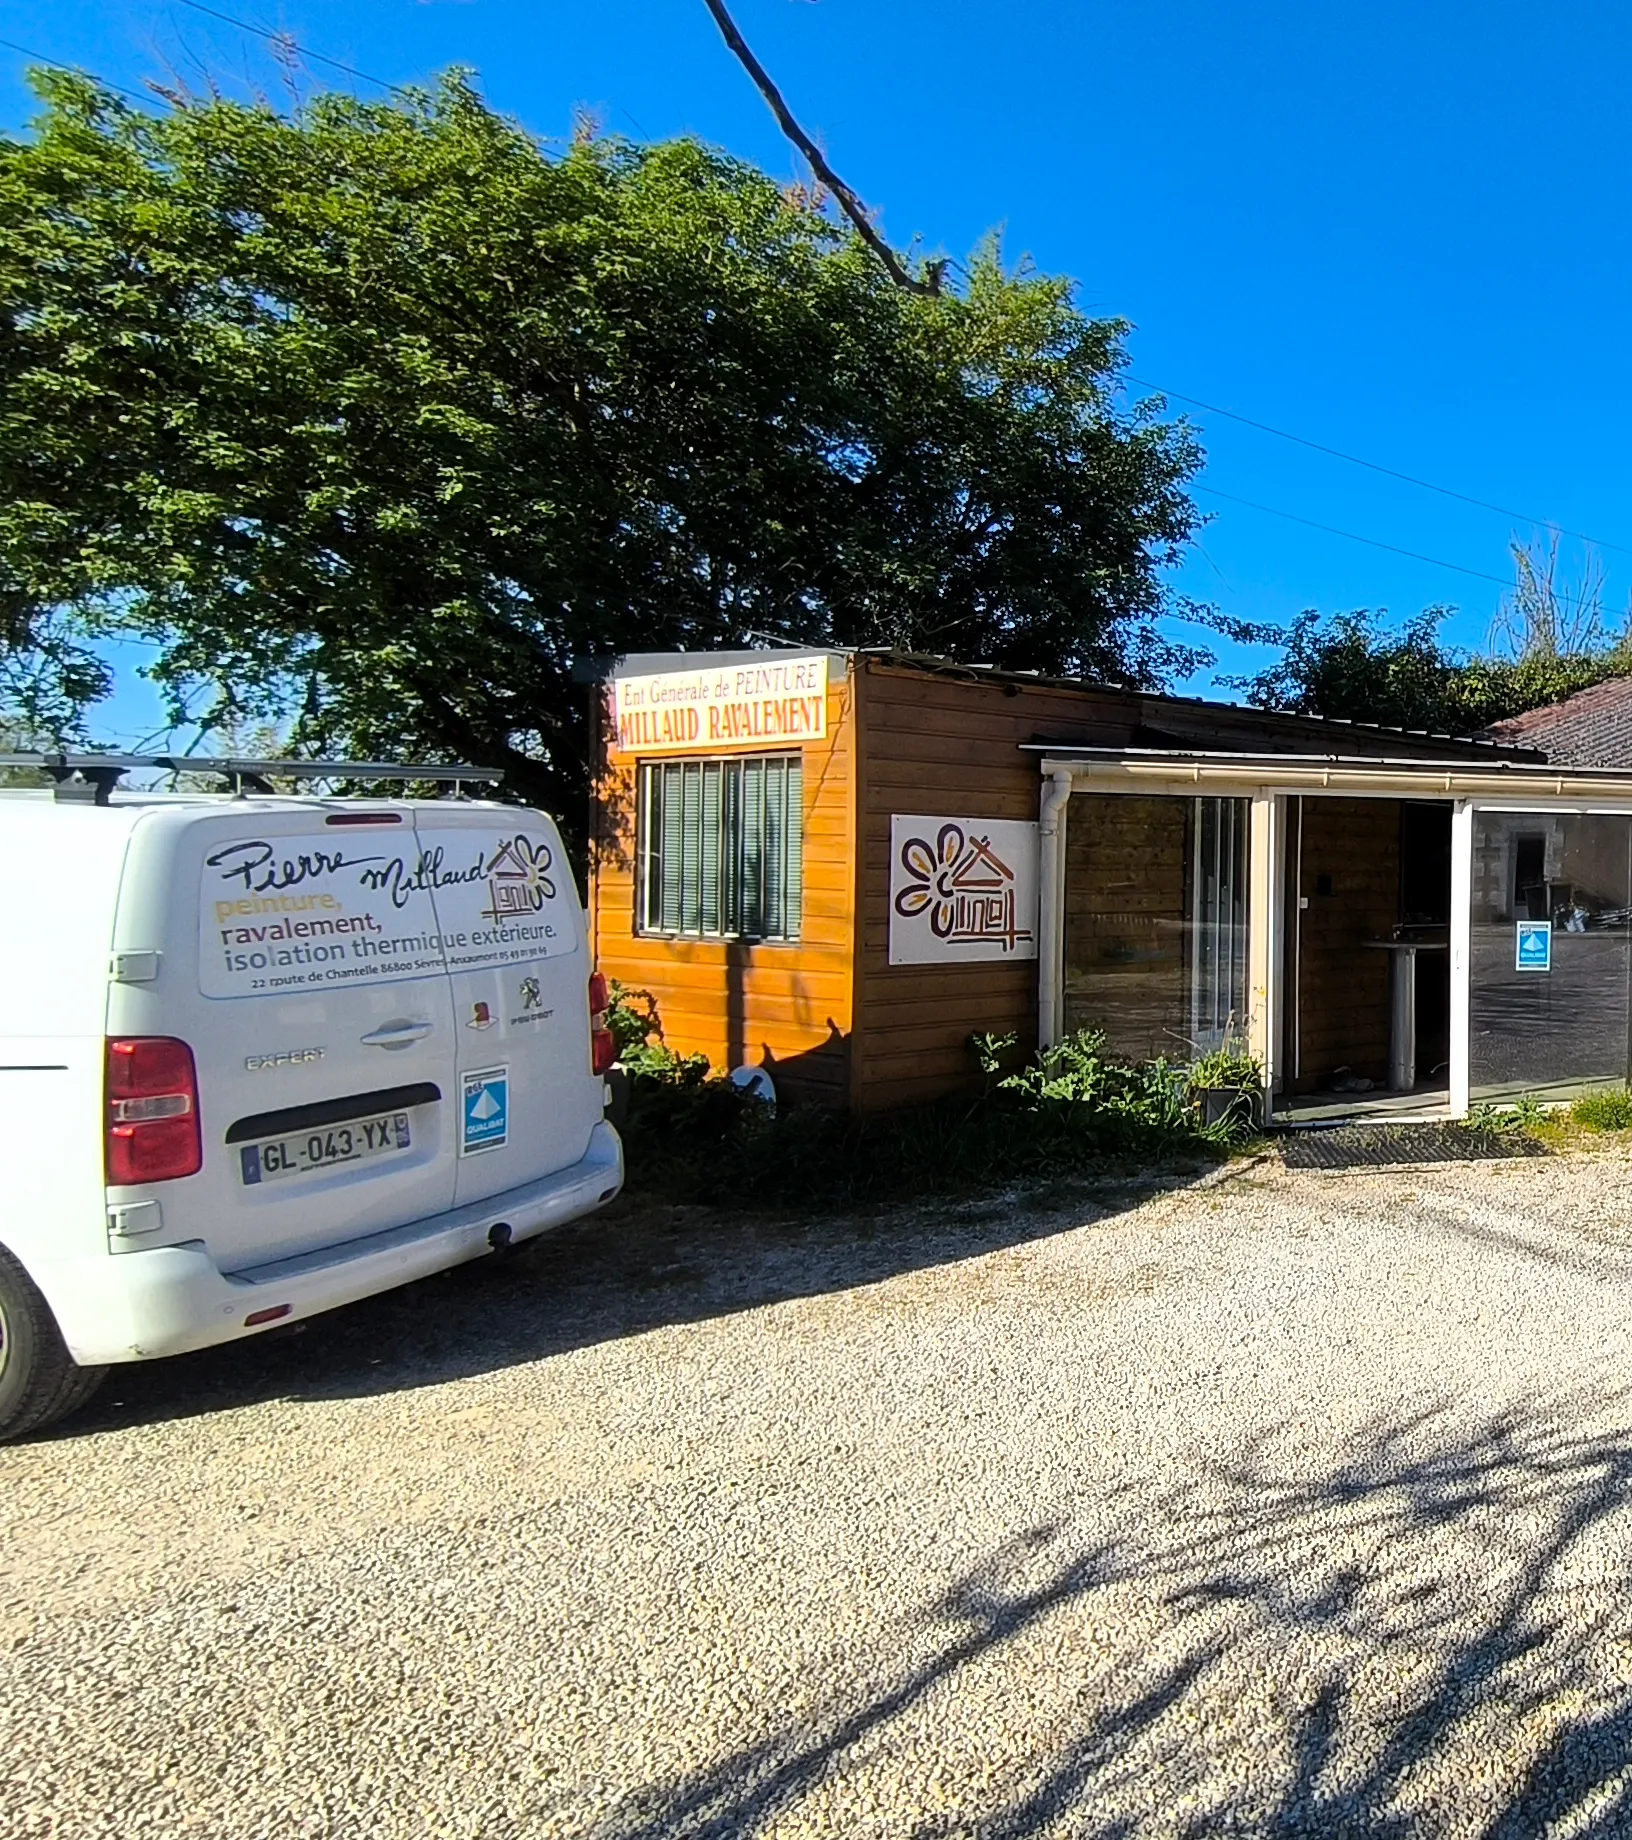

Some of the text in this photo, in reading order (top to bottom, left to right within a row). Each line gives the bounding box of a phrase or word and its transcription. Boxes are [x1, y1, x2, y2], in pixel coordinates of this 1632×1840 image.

[624, 662, 818, 706] Ent Générale de PEINTURE
[620, 695, 823, 747] MILLAUD RAVALEMENT
[206, 841, 489, 909] Pierre Millaud
[215, 892, 343, 923] peinture,
[220, 912, 383, 946] ravalement,
[224, 922, 557, 972] isolation thermique extérieure.
[251, 979, 266, 989] 22
[269, 974, 306, 987] route
[308, 969, 323, 982] de
[325, 963, 379, 979] Chantelle
[380, 959, 413, 974] 86800
[263, 1119, 392, 1173] GL-043-YX
